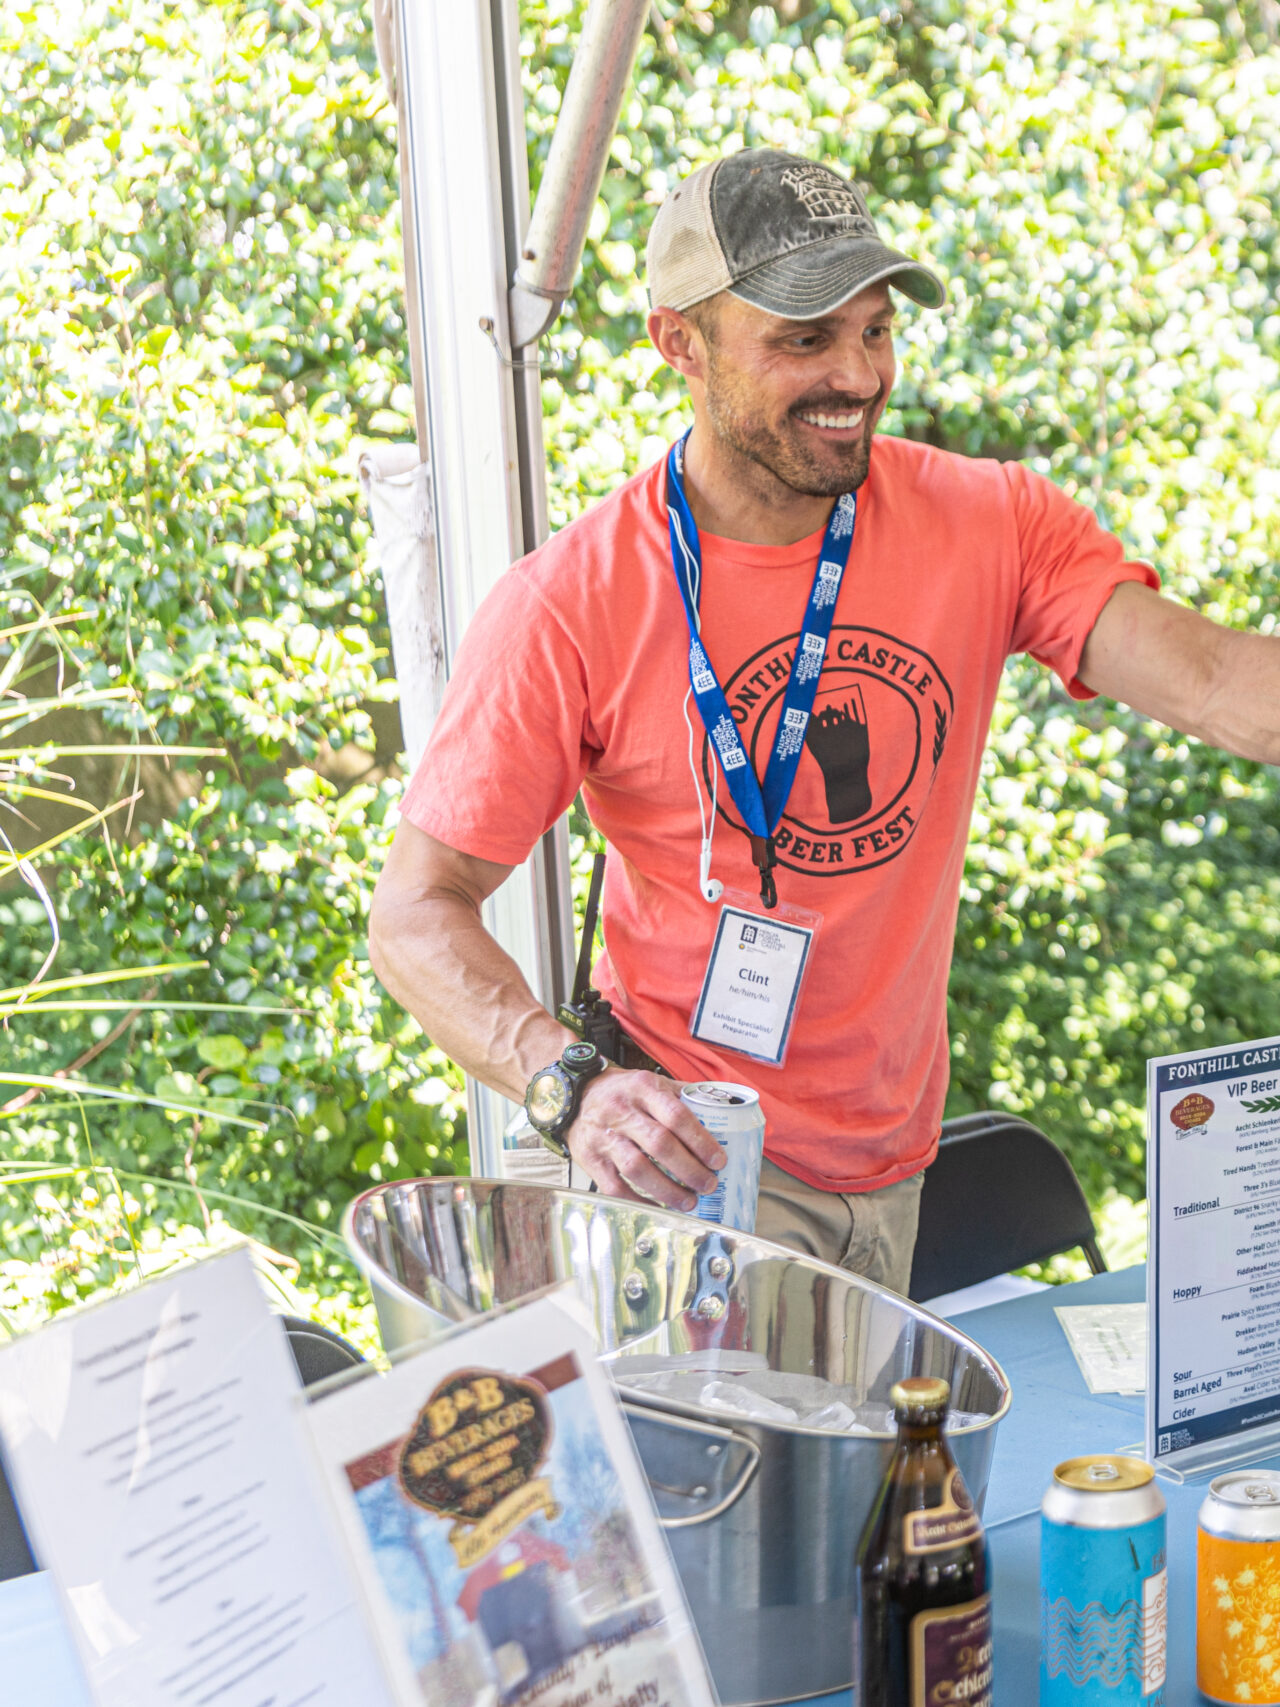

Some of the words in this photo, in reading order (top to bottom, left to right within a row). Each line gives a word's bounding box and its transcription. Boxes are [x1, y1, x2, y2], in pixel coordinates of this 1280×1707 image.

[837, 640, 933, 697] CASTLE
[774, 826, 844, 863] BEER
[851, 806, 915, 859] FEST
[739, 968, 770, 986] Clint
[713, 1011, 737, 1023] Exhibit
[722, 1023, 759, 1039] Preparator
[1169, 1056, 1239, 1080] FONTHILL
[1227, 1081, 1248, 1098] VIP
[1251, 1079, 1278, 1094] Beer
[1236, 1123, 1251, 1132] Aecht
[1236, 1143, 1253, 1152] Forest
[1260, 1139, 1273, 1147] Main
[1223, 1167, 1238, 1176] Tired
[1239, 1163, 1256, 1172] Hands
[1243, 1184, 1259, 1192] Three
[1269, 1179, 1280, 1187] Blue
[1173, 1197, 1220, 1217] Traditional
[1234, 1206, 1252, 1215] District
[1253, 1220, 1276, 1231] Alesmith
[1236, 1247, 1252, 1256] Other
[1253, 1243, 1265, 1251] Half
[1266, 1240, 1277, 1249] Out
[1236, 1262, 1268, 1277] Fiddlehead
[1173, 1284, 1202, 1301] Hoppy
[1249, 1285, 1265, 1294] Foam
[1221, 1312, 1240, 1321] Prairie
[1241, 1309, 1255, 1318] Spicy
[1235, 1327, 1257, 1338] Drekker
[1237, 1345, 1258, 1356] Hudson
[1259, 1341, 1276, 1350] Valley
[1173, 1370, 1193, 1383] Sour
[1226, 1369, 1243, 1378] Three
[1173, 1384, 1200, 1400] Barrel
[1201, 1377, 1222, 1393] Aged
[1173, 1407, 1196, 1420] Cider
[409, 1398, 536, 1477] BEVERAGES
